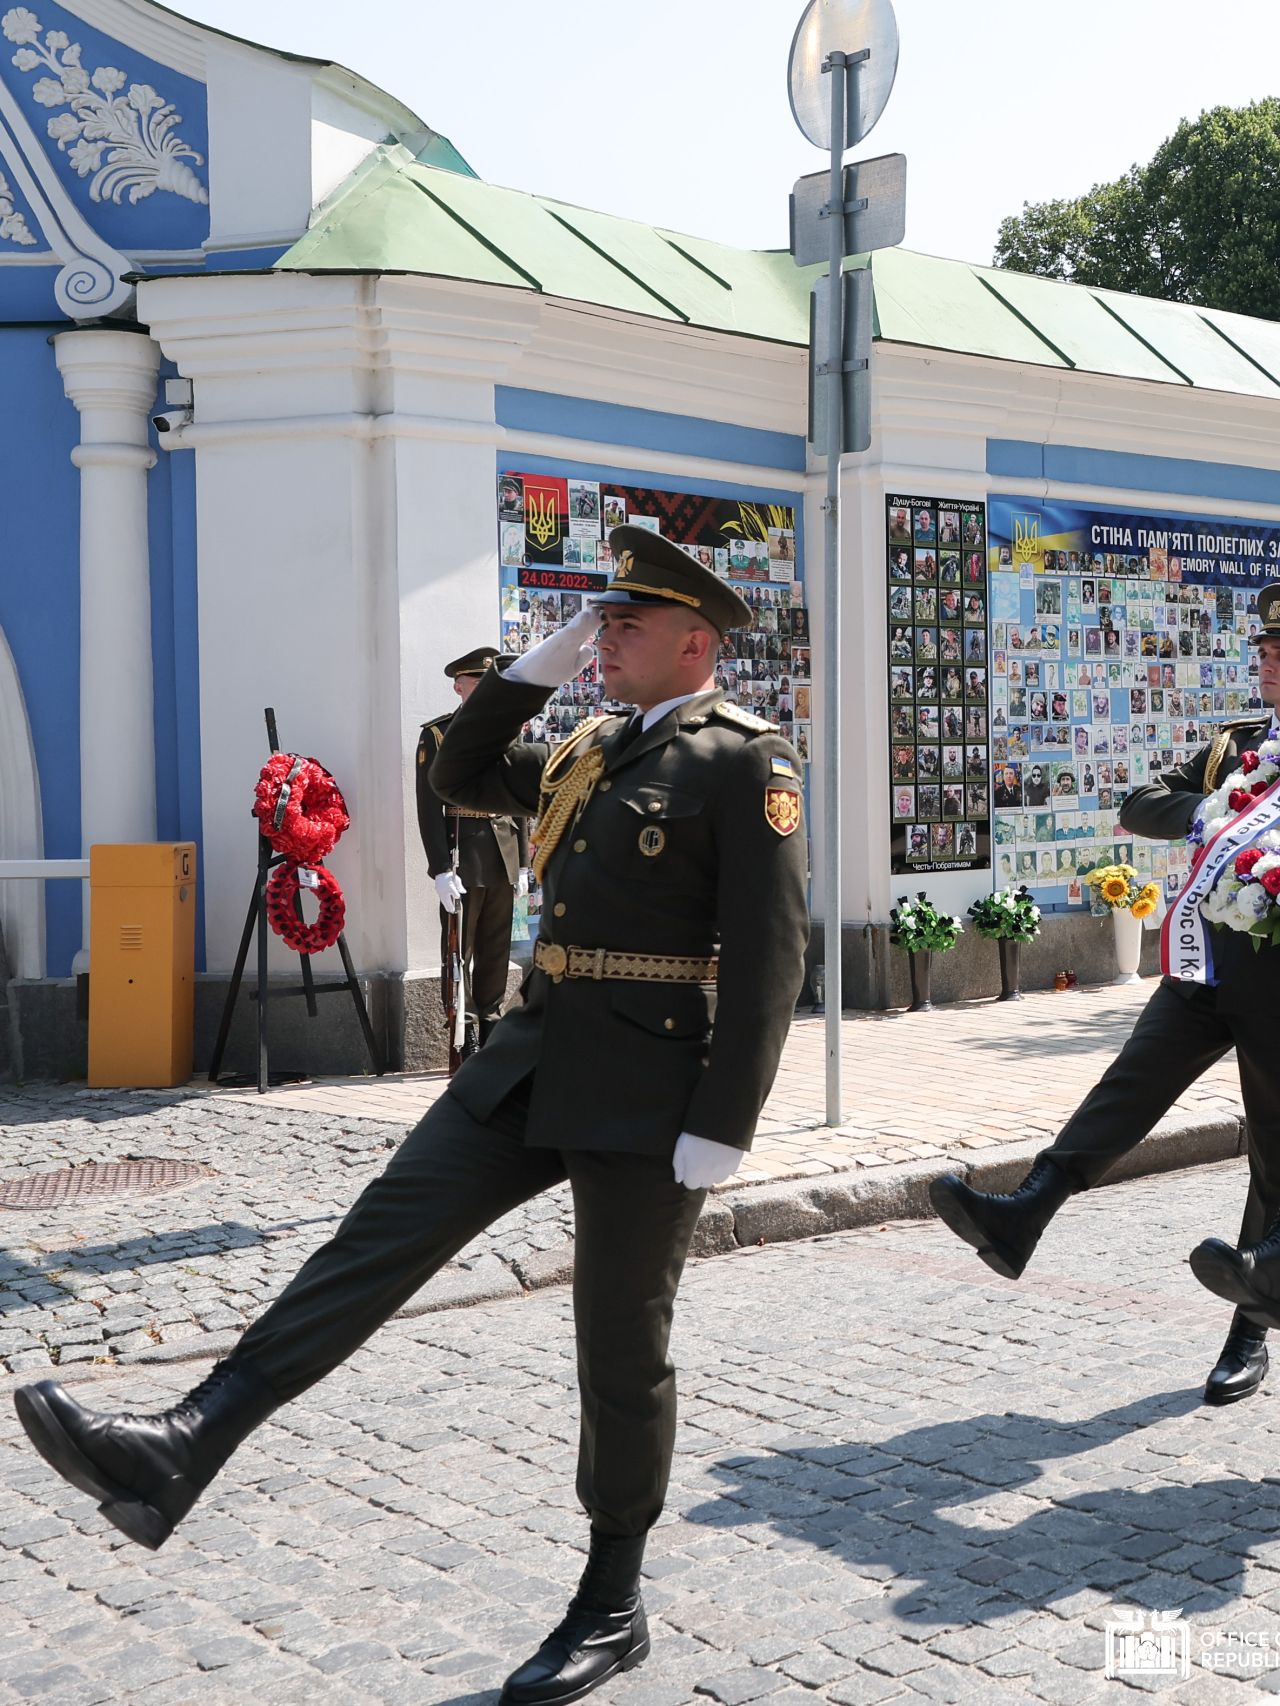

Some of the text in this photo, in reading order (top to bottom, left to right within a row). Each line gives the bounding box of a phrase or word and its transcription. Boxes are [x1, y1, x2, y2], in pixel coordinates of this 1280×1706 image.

[892, 497, 932, 508] Душу-Богові
[1091, 525, 1133, 547] СТІНА
[1197, 534, 1264, 557] ПОЛЕГЛИХ
[1181, 557, 1216, 574] EMORY
[1220, 560, 1246, 576] WALL
[1250, 562, 1261, 577] OF
[1237, 813, 1271, 835] the
[1180, 935, 1200, 951] of
